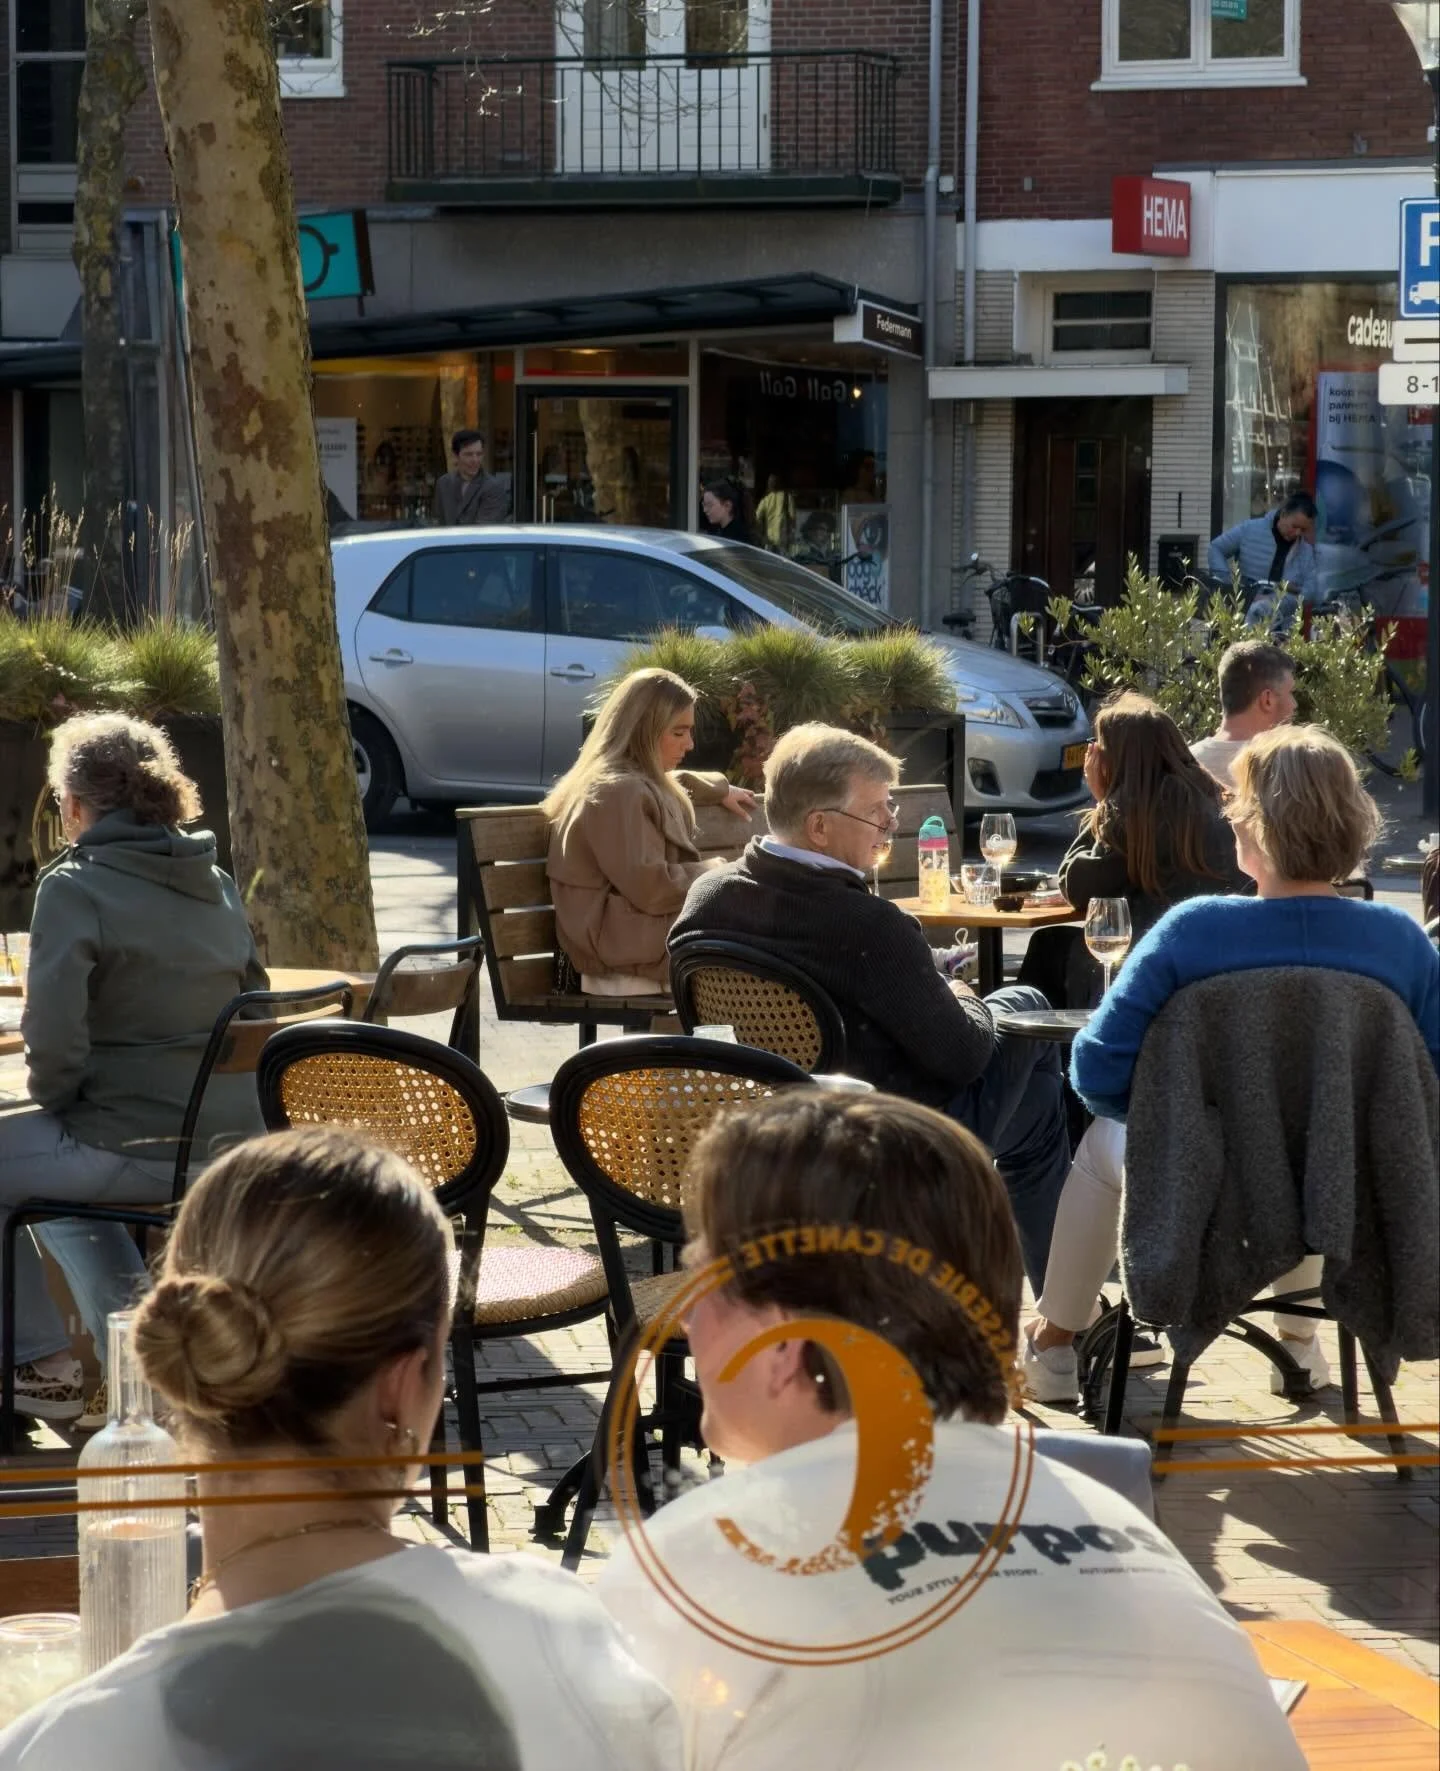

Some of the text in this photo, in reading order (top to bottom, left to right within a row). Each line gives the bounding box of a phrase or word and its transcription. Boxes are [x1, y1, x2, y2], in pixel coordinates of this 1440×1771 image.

[1143, 196, 1187, 240] HEMA
[876, 313, 912, 341] Federmann
[887, 1584, 924, 1606] YOUR
